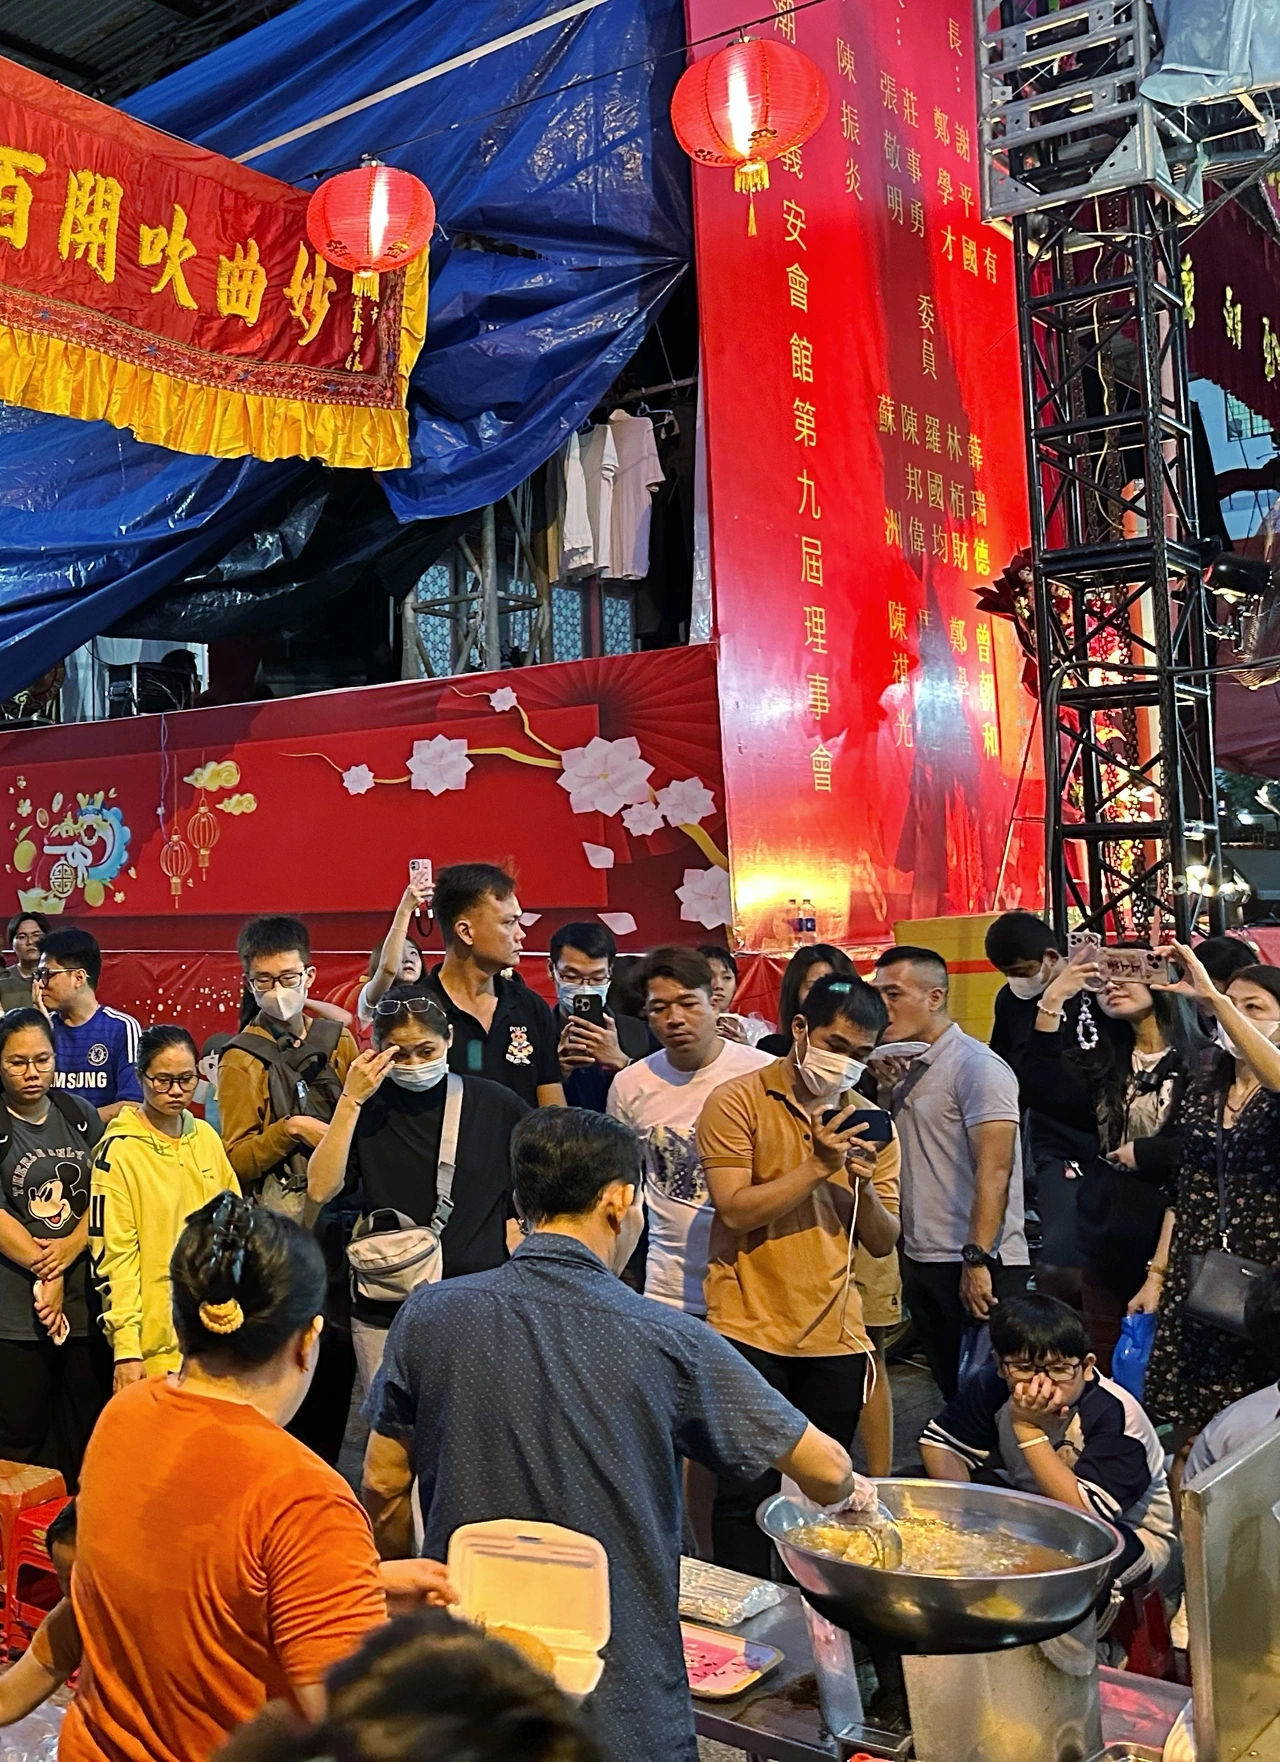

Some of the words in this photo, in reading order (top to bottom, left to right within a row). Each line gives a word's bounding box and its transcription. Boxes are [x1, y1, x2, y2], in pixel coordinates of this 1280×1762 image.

[836, 37, 863, 201] 陳振炎
[880, 70, 904, 226] 張敬明
[933, 106, 957, 262] 鄭學才
[773, 0, 833, 793] 潮義安會館第九屆理事會
[917, 294, 936, 380] 委員
[901, 404, 926, 556] 陳邦偉
[925, 414, 948, 563] 羅國均
[50, 1072, 108, 1089] MSUNG
